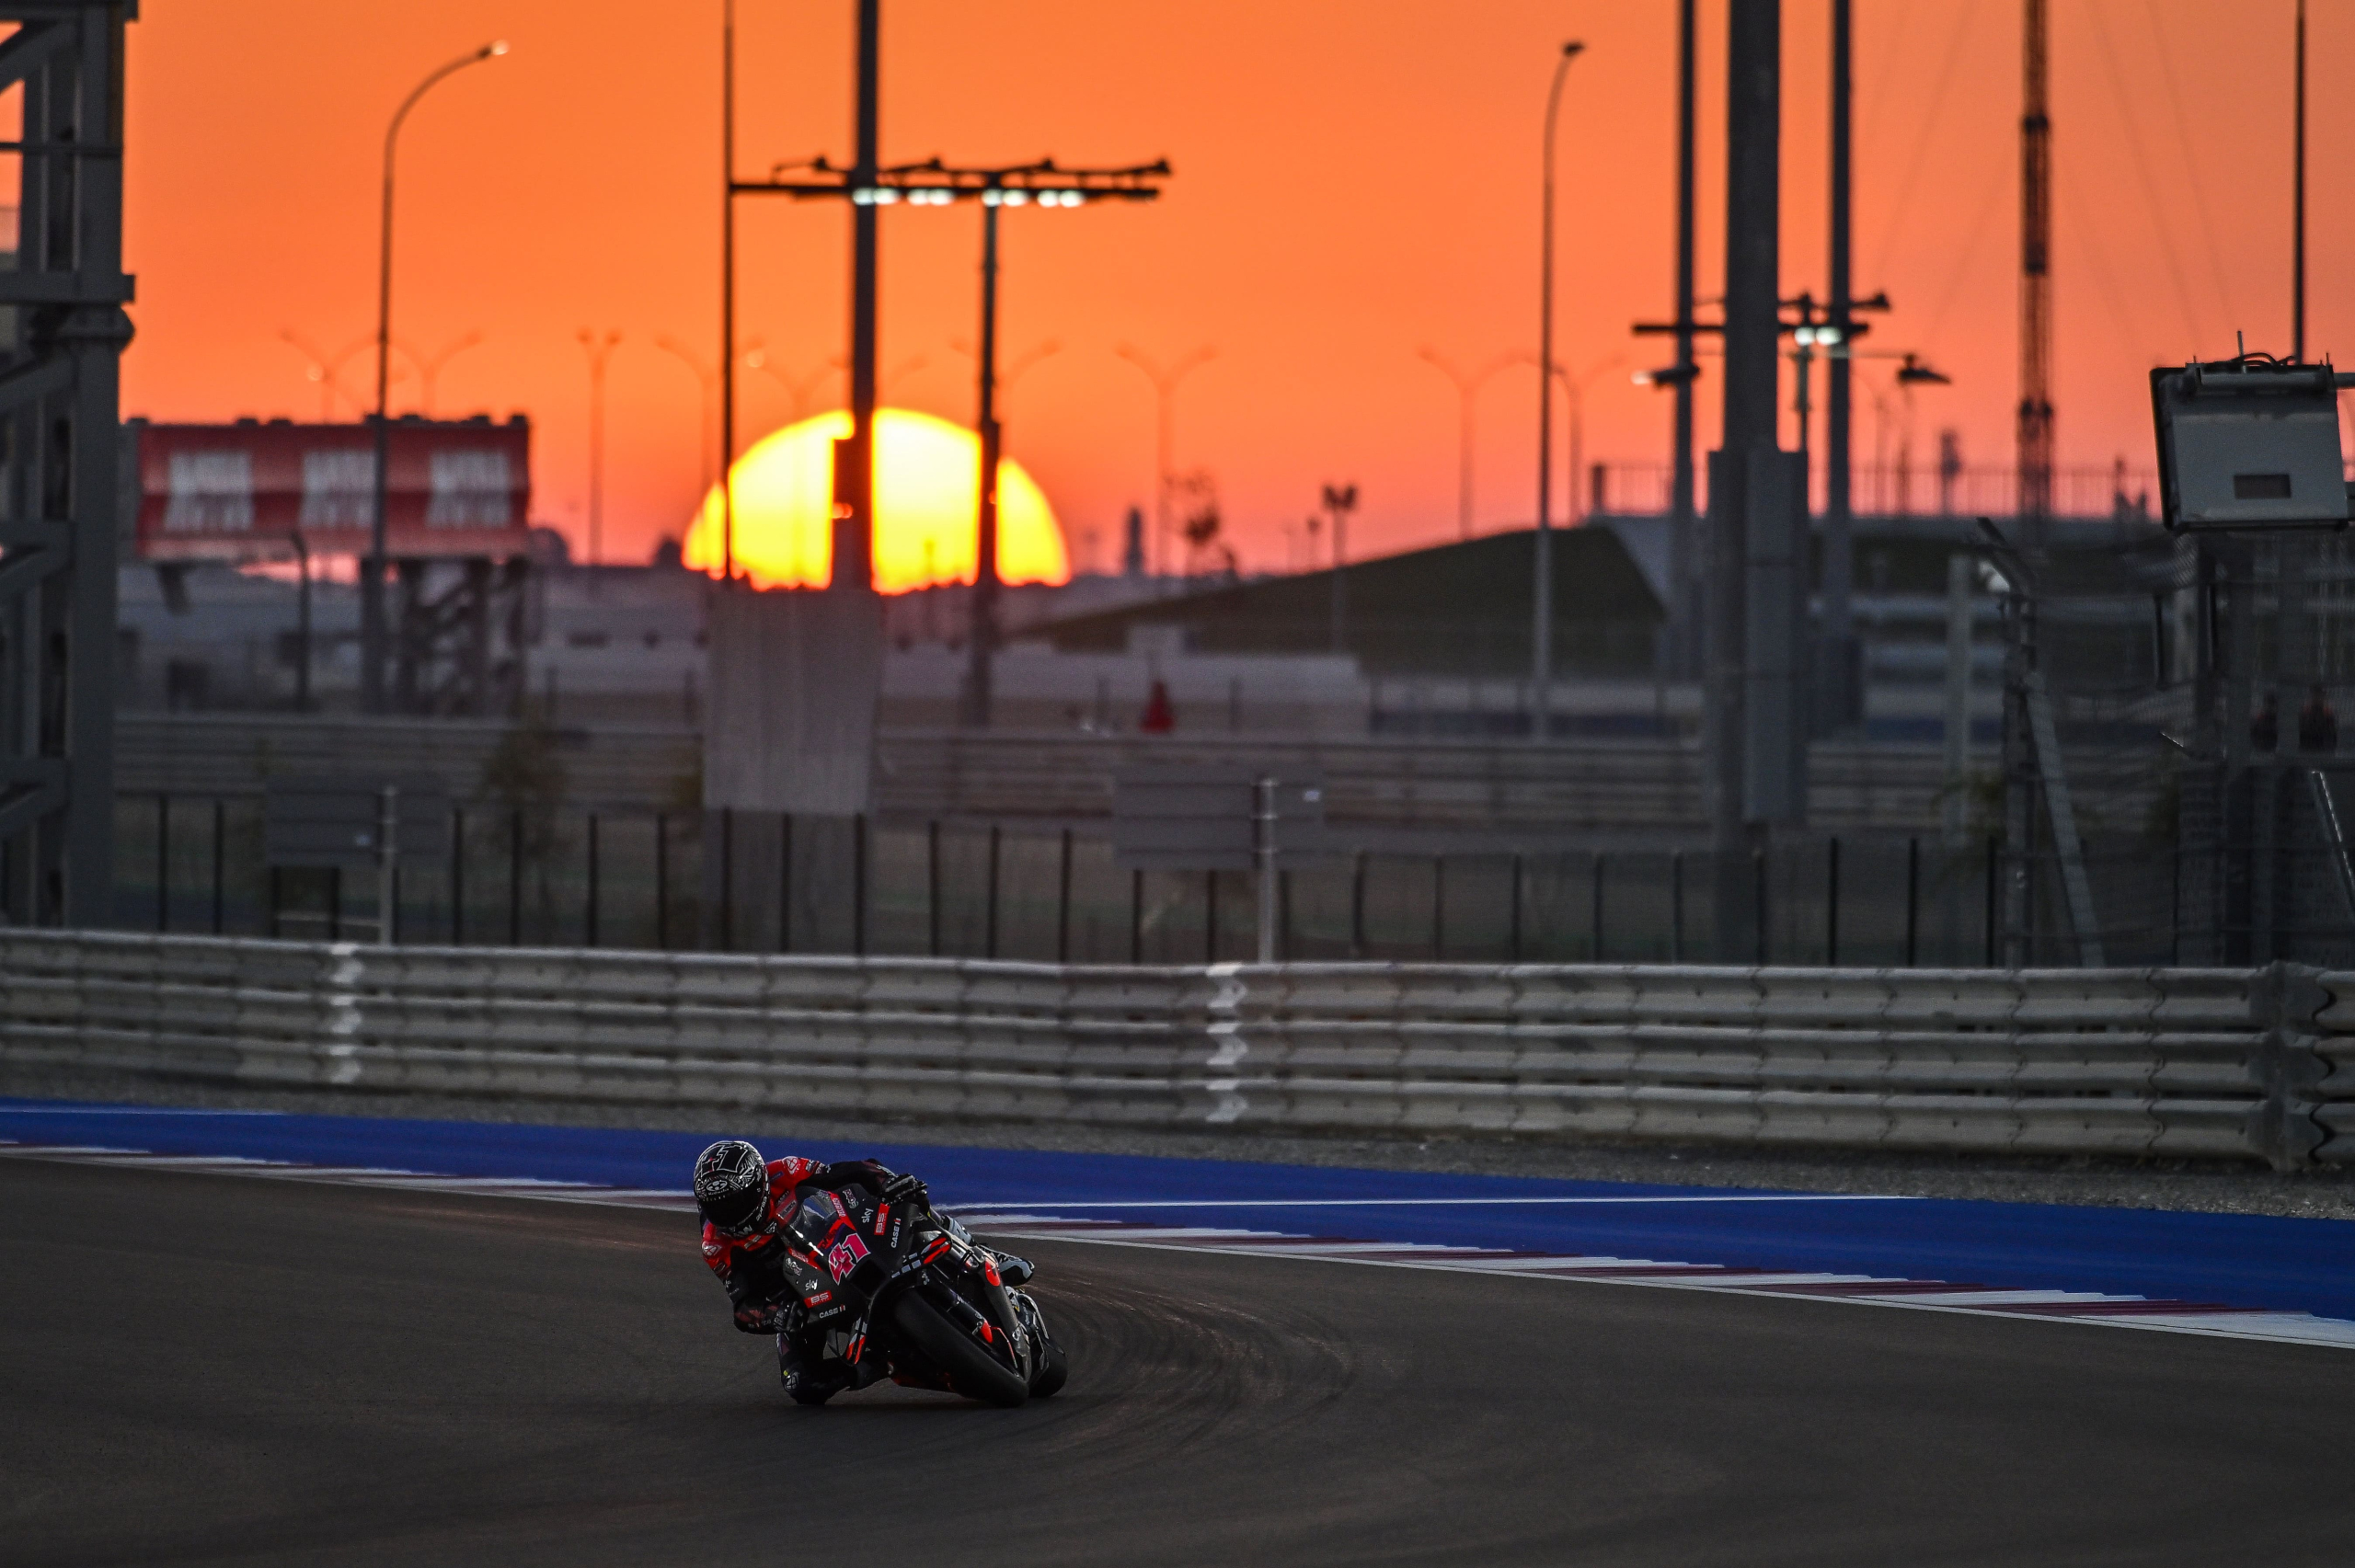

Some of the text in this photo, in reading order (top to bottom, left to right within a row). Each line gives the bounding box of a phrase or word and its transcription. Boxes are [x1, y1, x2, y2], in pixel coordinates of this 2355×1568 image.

[861, 1207, 874, 1224] sky
[876, 1213, 885, 1233] BS
[890, 1225, 901, 1249] CASE
[828, 1232, 871, 1286] 41
[805, 1278, 818, 1291] sky
[810, 1292, 829, 1304] BS
[819, 1307, 839, 1319] CASE
